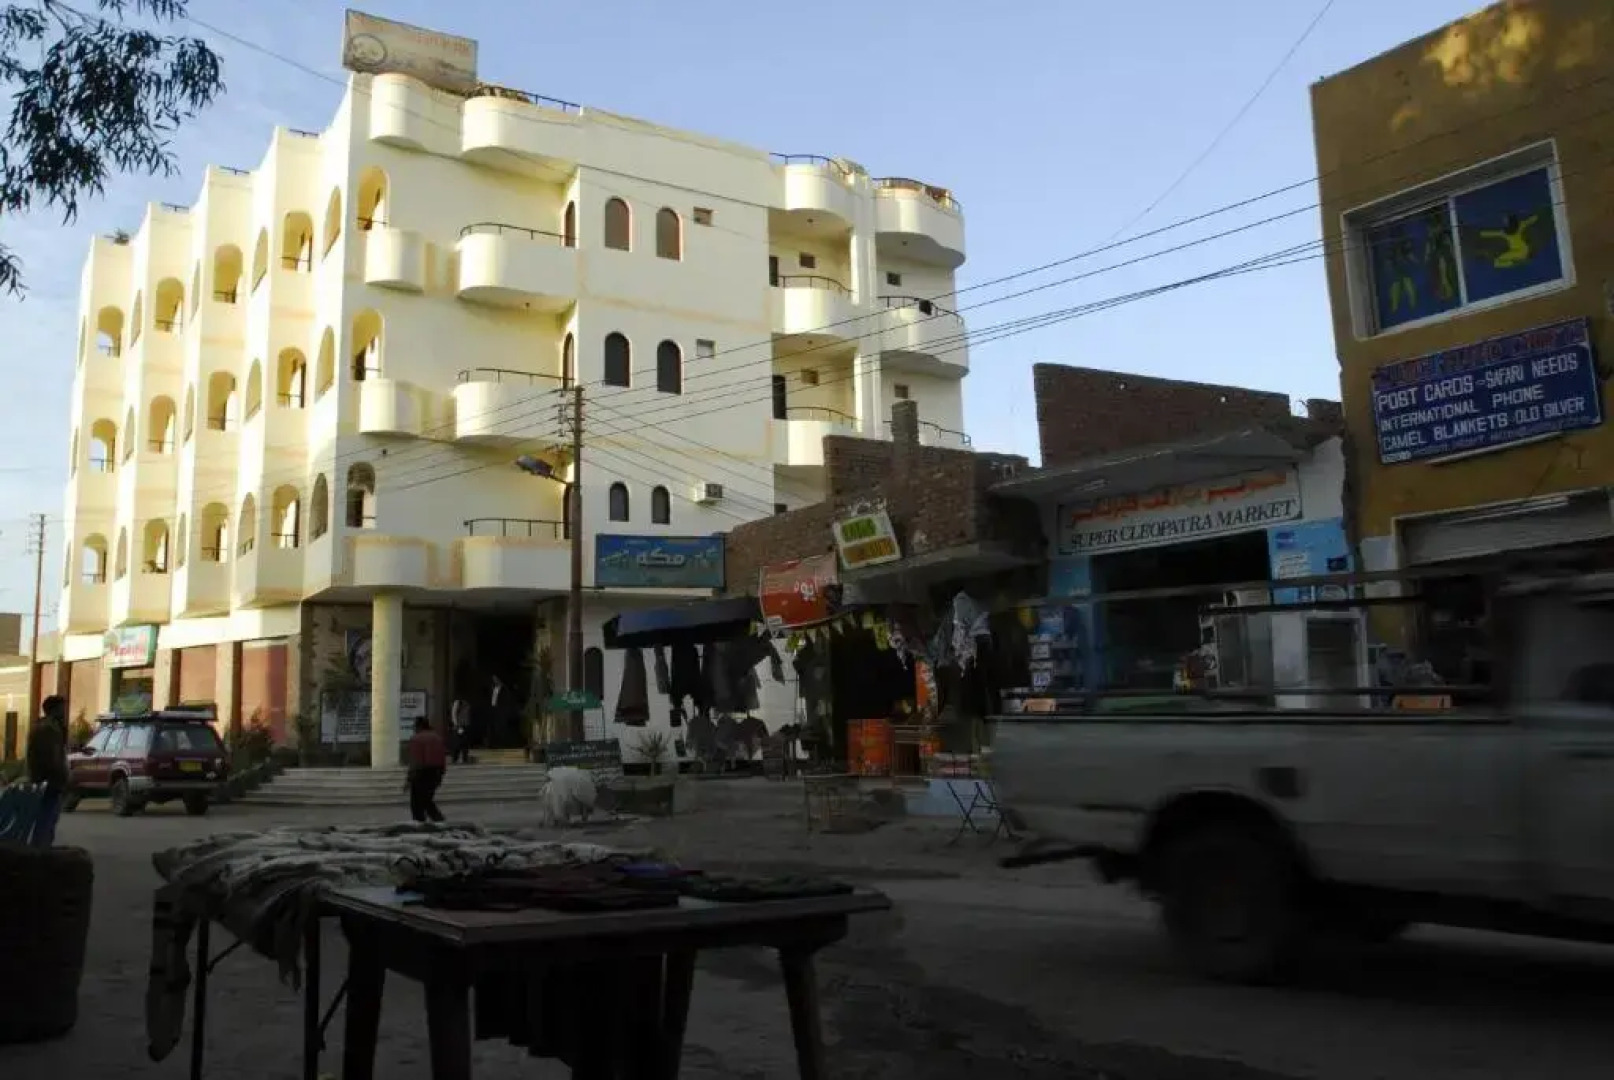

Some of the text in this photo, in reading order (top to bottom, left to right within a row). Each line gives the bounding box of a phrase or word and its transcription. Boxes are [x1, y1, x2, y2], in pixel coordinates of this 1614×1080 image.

[1377, 387, 1418, 413] POST
[1424, 374, 1474, 402] CARDS
[1531, 352, 1578, 378] NEEDS
[1380, 384, 1545, 432] INTERNATIONAL PHONE
[1383, 430, 1427, 451] CAMEL
[1433, 415, 1508, 441] BLANKETS
[1514, 405, 1541, 426] OLD
[1543, 396, 1585, 418] SILVER
[1071, 498, 1297, 548] SUPER CLEOPATRA MARKET
